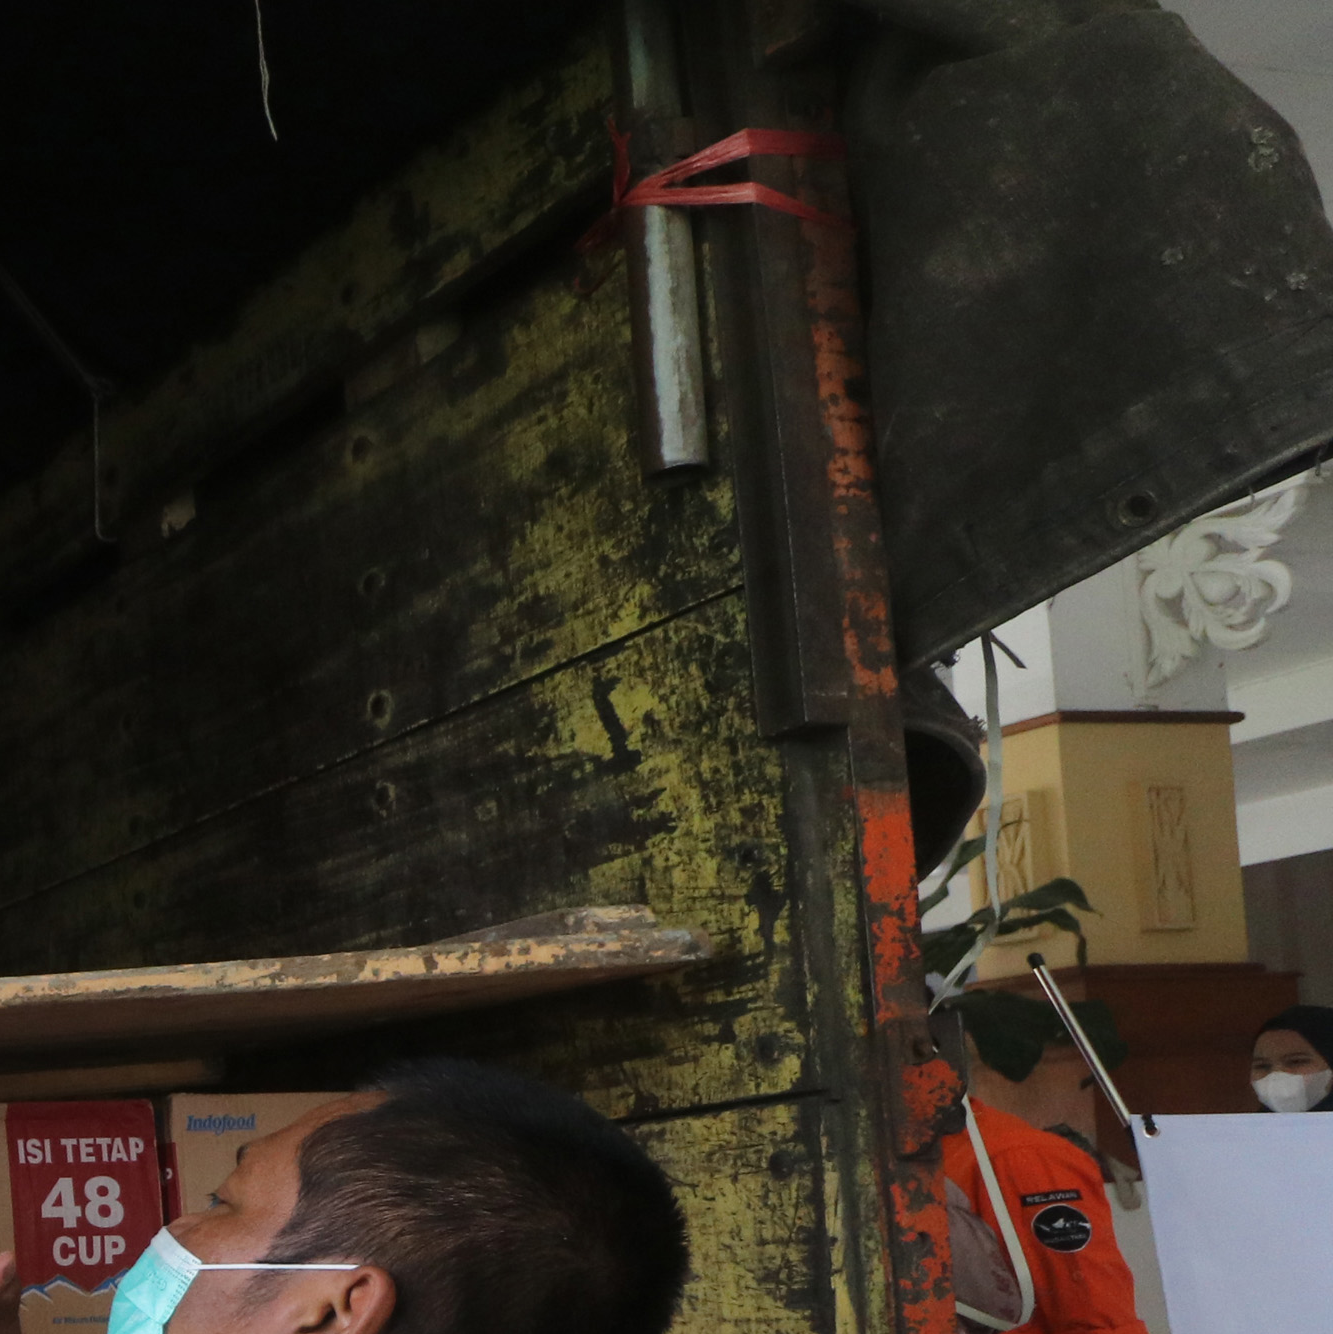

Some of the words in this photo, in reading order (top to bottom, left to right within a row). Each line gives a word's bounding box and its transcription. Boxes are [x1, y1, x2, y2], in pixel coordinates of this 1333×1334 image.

[187, 1114, 257, 1135] Indofood
[16, 1137, 52, 1165] ISI
[60, 1136, 145, 1164] TETAP
[41, 1175, 125, 1229] 48
[52, 1234, 126, 1267] CUP
